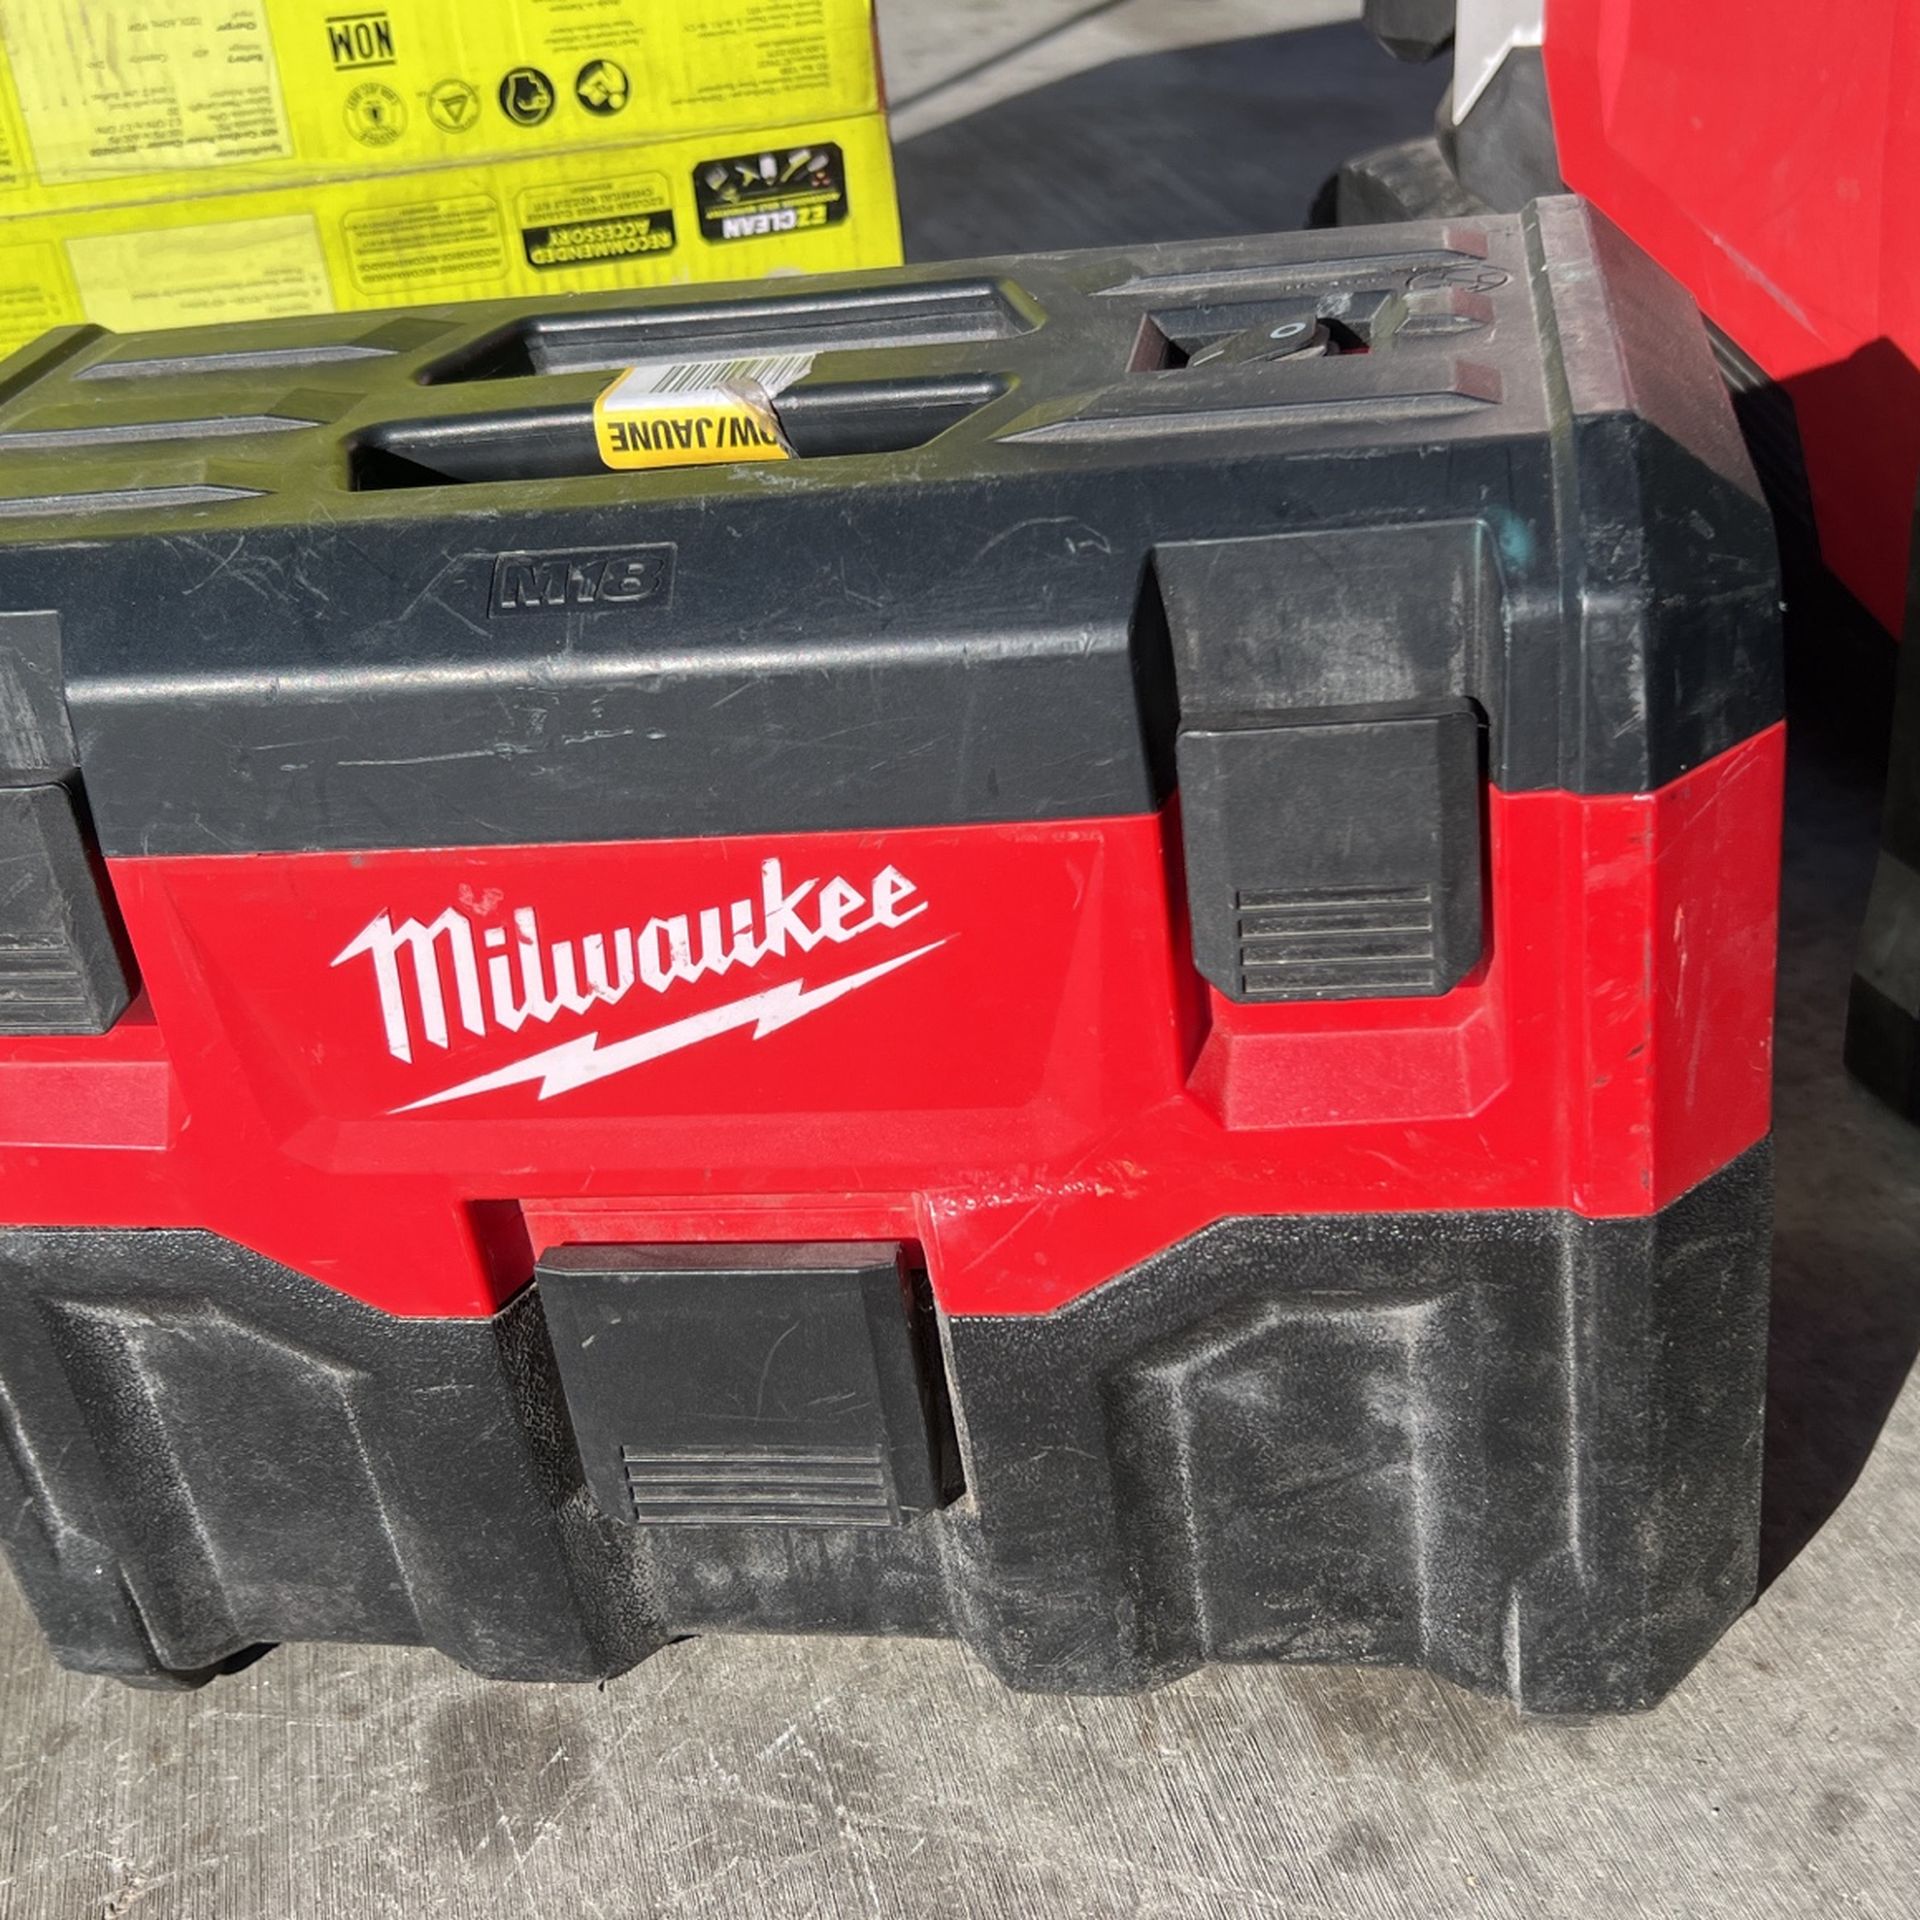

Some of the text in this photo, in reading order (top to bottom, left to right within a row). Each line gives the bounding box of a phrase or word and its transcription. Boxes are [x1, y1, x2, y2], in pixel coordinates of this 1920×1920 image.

[327, 21, 394, 63] NOM
[549, 218, 650, 247] ACCESSORY
[723, 204, 827, 239] EZCLEAN
[530, 232, 672, 264] RECOMMENDED
[500, 555, 666, 608] M18
[330, 858, 928, 1063] Milwaukee
